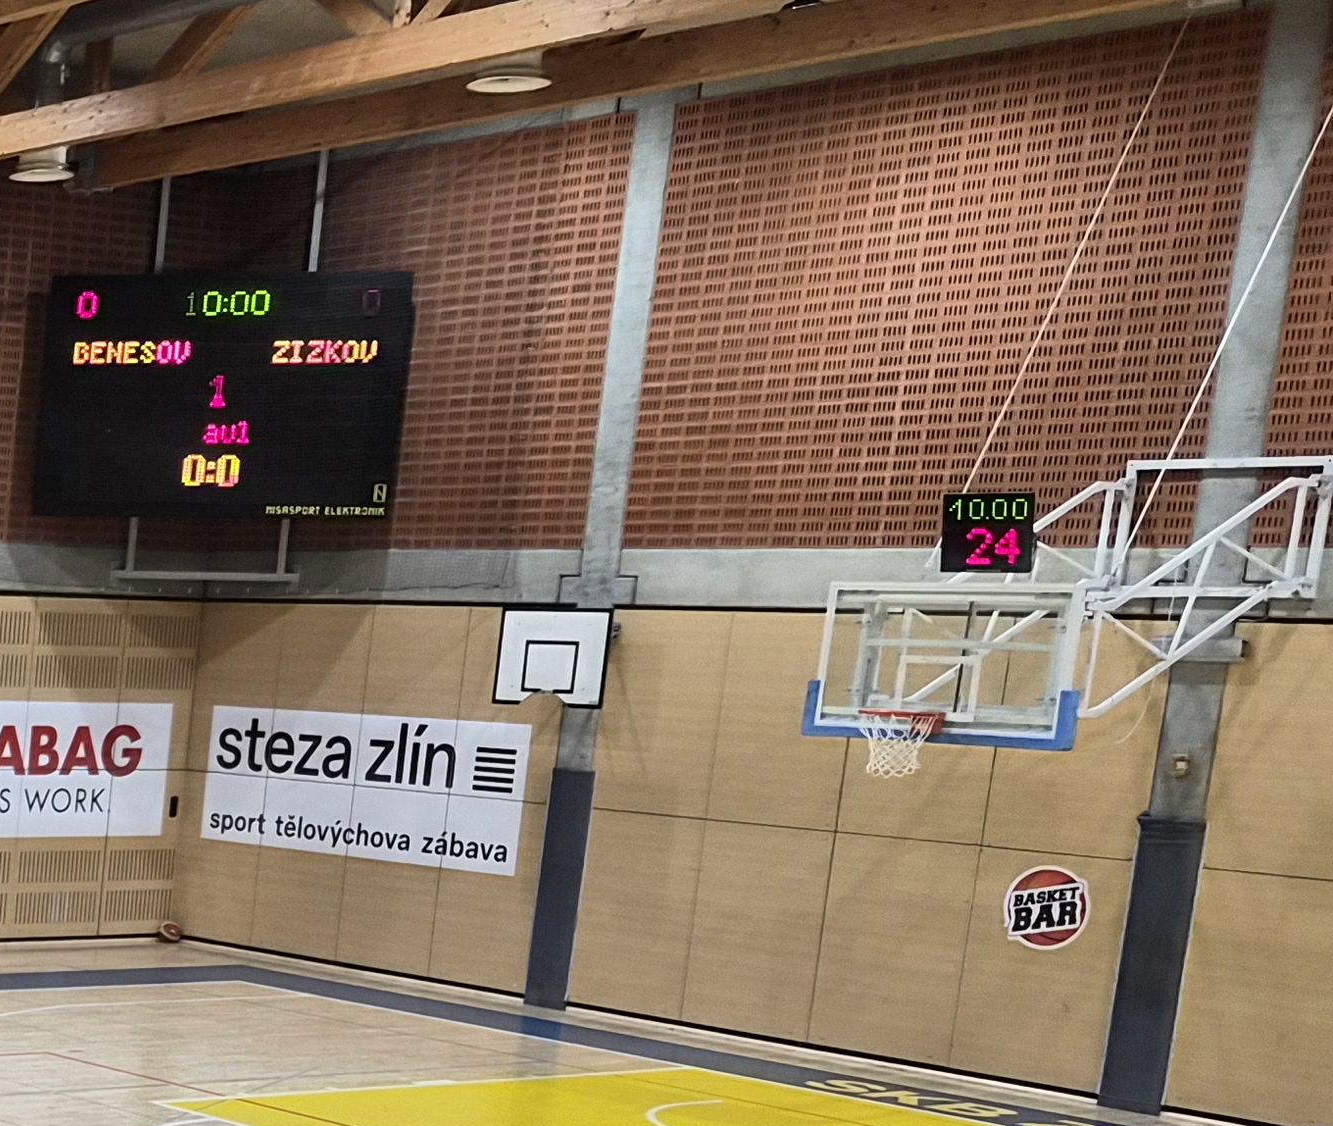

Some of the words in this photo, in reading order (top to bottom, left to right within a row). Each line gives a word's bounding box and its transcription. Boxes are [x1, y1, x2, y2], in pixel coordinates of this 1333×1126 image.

[76, 290, 99, 319] 0
[185, 289, 271, 317] 10:00
[362, 289, 381, 317] 0
[73, 339, 193, 365] BENESOV
[270, 339, 379, 365] ZIZKOV
[209, 374, 226, 408] 1
[181, 454, 241, 487] 0:0
[324, 506, 386, 516] ELEKTRONIK
[948, 498, 1028, 520] 10.00
[965, 528, 1021, 565] 24
[216, 718, 353, 780] steza
[364, 723, 457, 789] zlín
[209, 811, 266, 835] sport
[275, 814, 411, 852] tělovýchova
[421, 831, 509, 863] zábava
[1013, 886, 1080, 907] BASKET
[1011, 901, 1078, 932] BAR
[804, 1078, 1020, 1118] SKB
